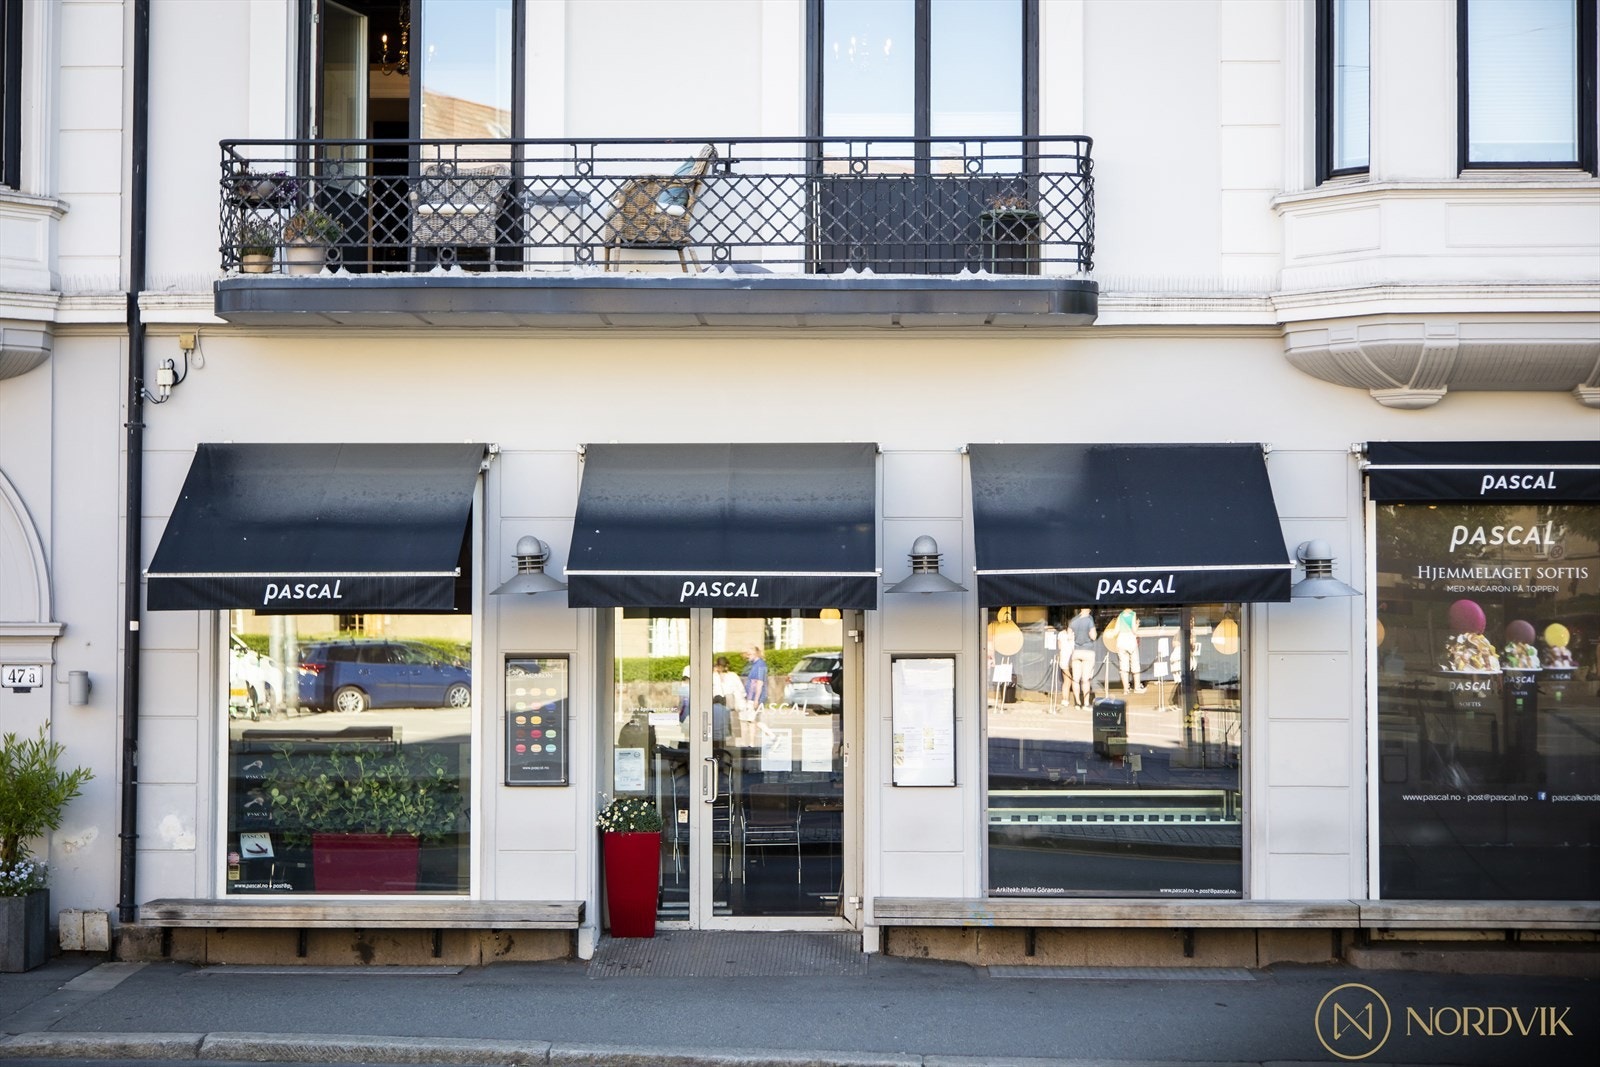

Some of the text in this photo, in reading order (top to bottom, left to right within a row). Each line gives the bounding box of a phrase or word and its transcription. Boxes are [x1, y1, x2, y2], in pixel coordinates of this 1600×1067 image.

[1418, 565, 1589, 581] HJEMMELAGET SOFTIS
[1446, 583, 1560, 593] MED MACARON PÅ TOPPEN
[8, 669, 26, 683] 47
[744, 698, 810, 716] ASCAL
[1402, 793, 1461, 802] www.pascal.no
[1467, 793, 1529, 802] post@pascal.no
